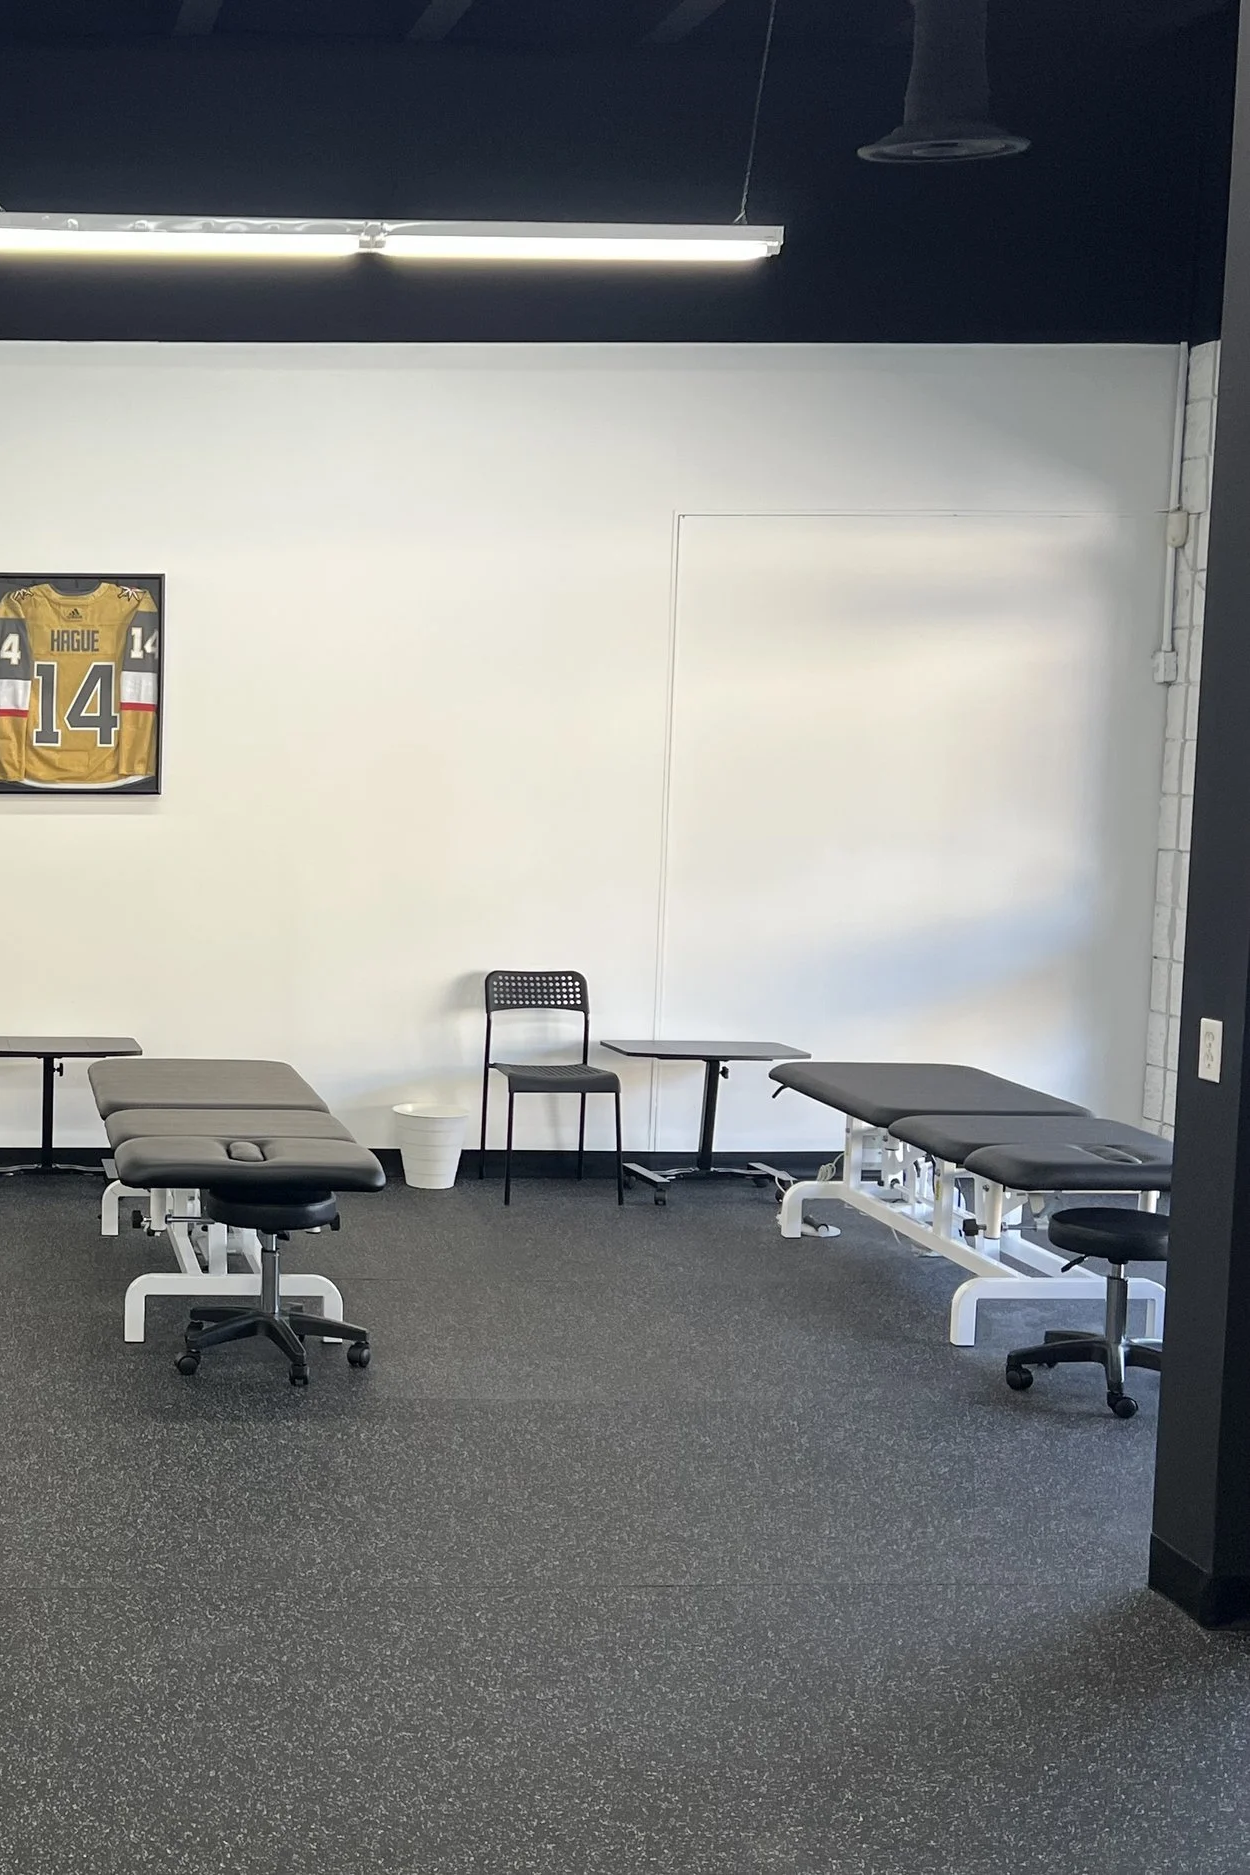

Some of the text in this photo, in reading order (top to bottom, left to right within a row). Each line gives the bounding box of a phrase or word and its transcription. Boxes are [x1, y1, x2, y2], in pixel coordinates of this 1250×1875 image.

[51, 629, 99, 652] HAGUE
[130, 626, 159, 660] 14
[33, 661, 120, 747] 14
